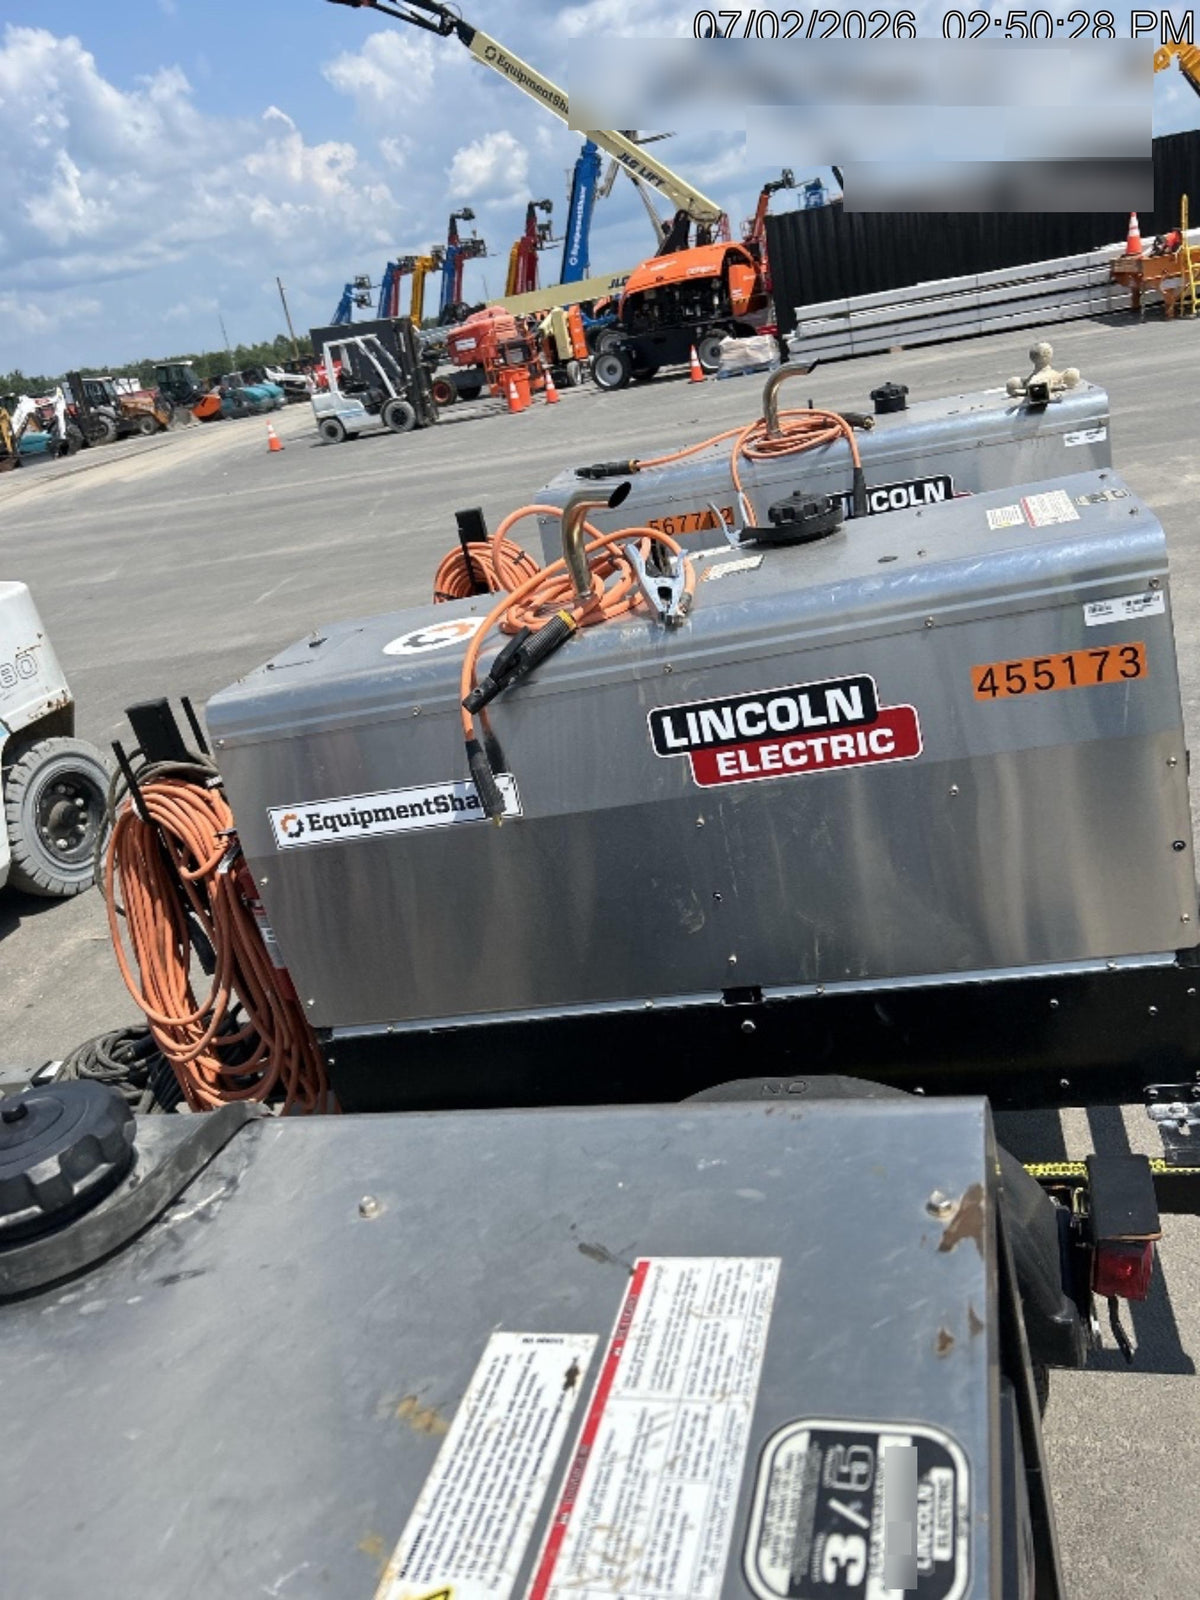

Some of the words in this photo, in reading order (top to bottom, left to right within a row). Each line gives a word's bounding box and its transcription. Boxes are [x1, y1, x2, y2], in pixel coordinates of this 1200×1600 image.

[497, 53, 568, 114] EquipmentSh
[617, 153, 640, 169] JLG
[638, 167, 664, 187] LIFT
[830, 480, 945, 519] ICOLN
[977, 646, 1141, 698] 455173
[661, 685, 865, 748] LINCOLN
[715, 727, 896, 777] ELECTRIC
[306, 794, 480, 832] EquipmentSha
